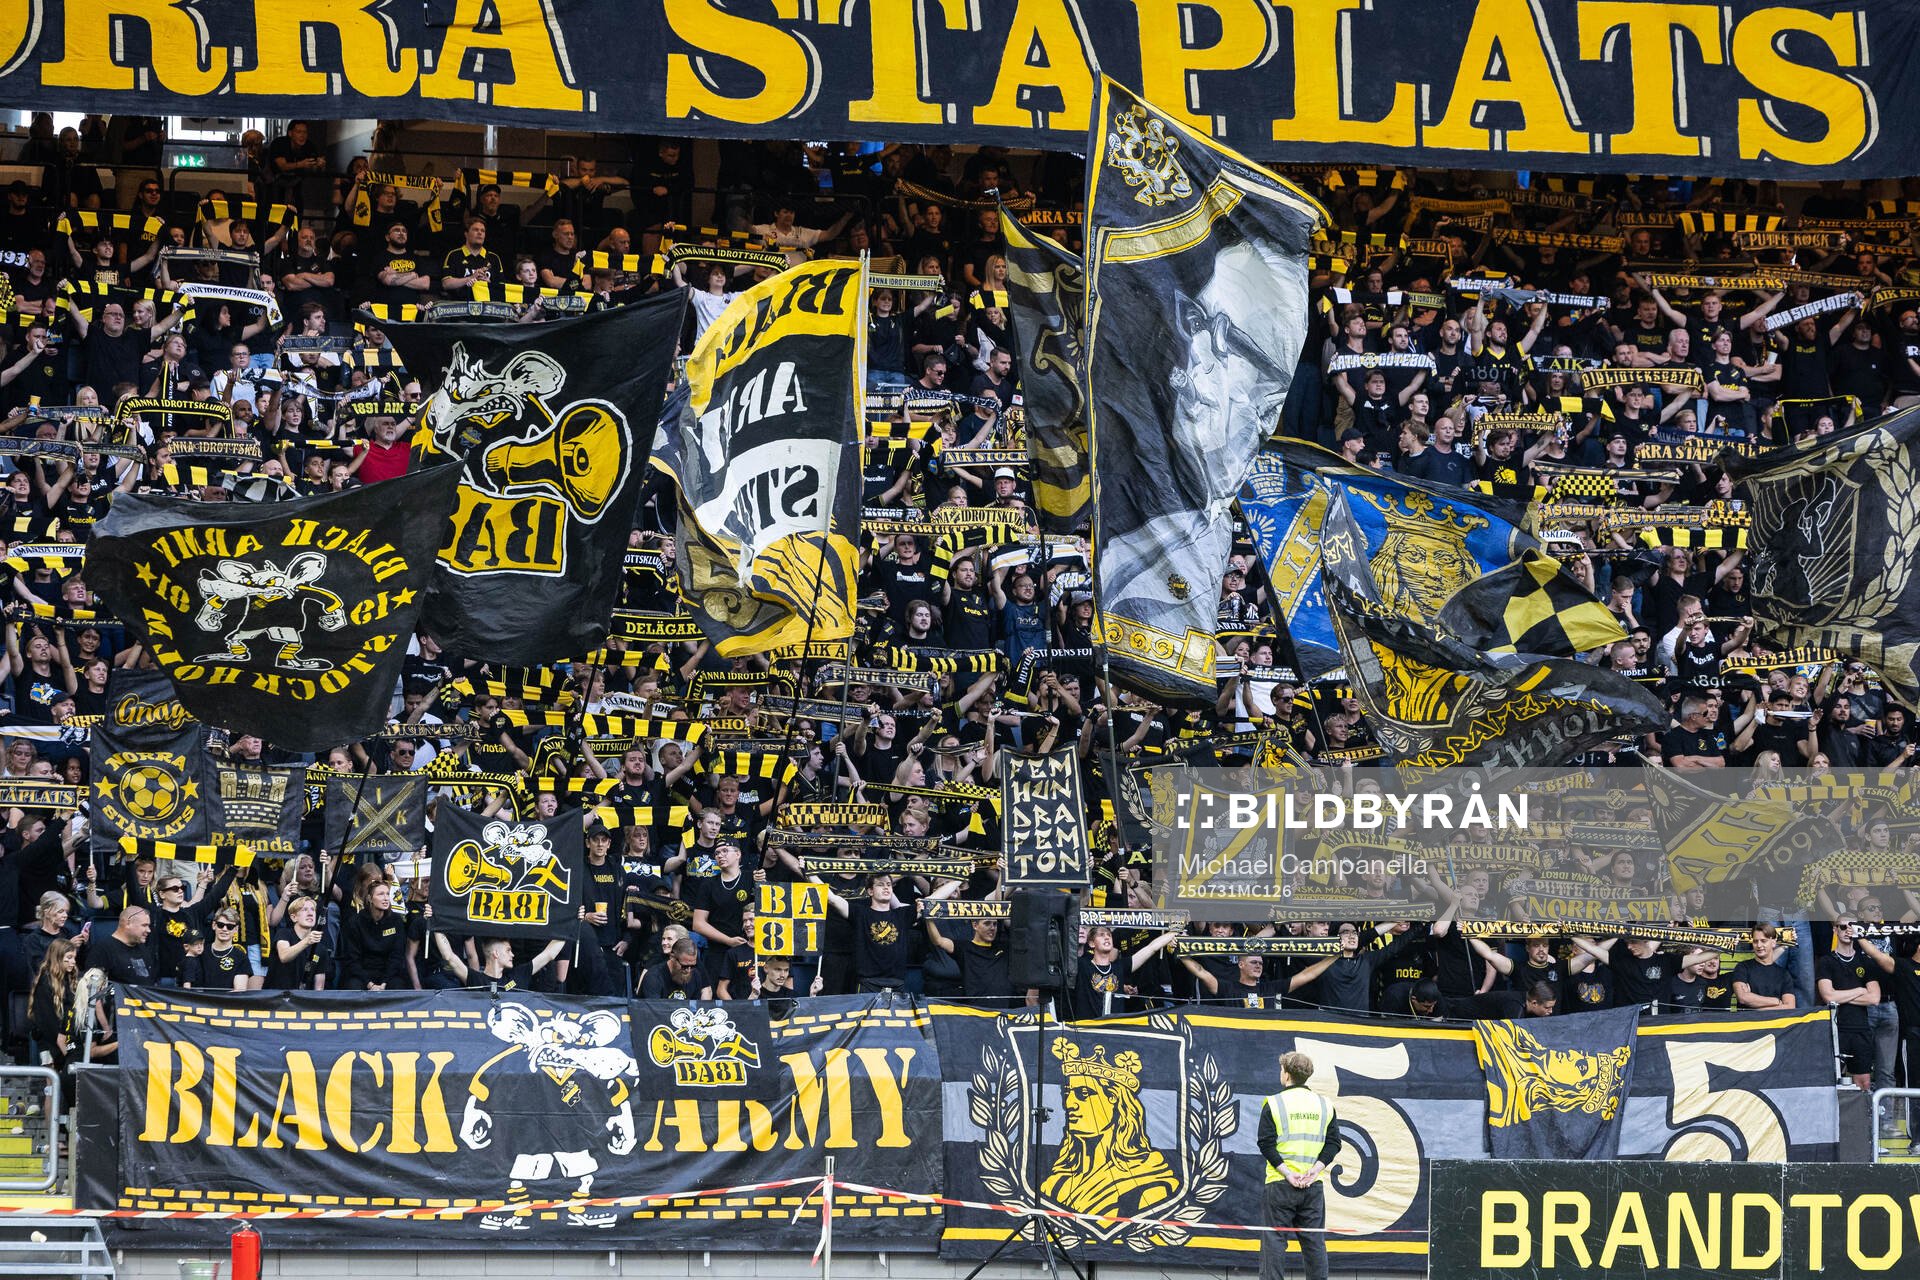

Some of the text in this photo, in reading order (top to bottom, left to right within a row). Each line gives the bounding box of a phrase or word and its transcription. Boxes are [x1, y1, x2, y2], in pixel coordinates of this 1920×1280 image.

[671, 246, 789, 269] ALLMÄNNA IDROTTSKLUBBEN
[1550, 359, 1585, 371] AIK
[352, 402, 379, 414] 1891
[384, 402, 405, 414] AIK
[944, 451, 969, 464] AIK
[104, 752, 187, 773] NORRA
[1010, 752, 1073, 779] FEM
[1011, 780, 1073, 804] HUN
[102, 804, 197, 840] STÅPLATS
[1012, 803, 1076, 828] DRA
[1012, 825, 1080, 854] FEM
[805, 861, 868, 873] NORRA
[1014, 850, 1082, 878] TON
[474, 891, 548, 922] BA81
[1111, 911, 1165, 926] HAMRIN
[1528, 895, 1621, 921] NORRA
[1178, 940, 1239, 953] NORRA
[1630, 926, 1736, 950] IDROTTSKLUBBEN
[678, 1061, 745, 1085] BA81
[138, 1040, 460, 1154] BLACK
